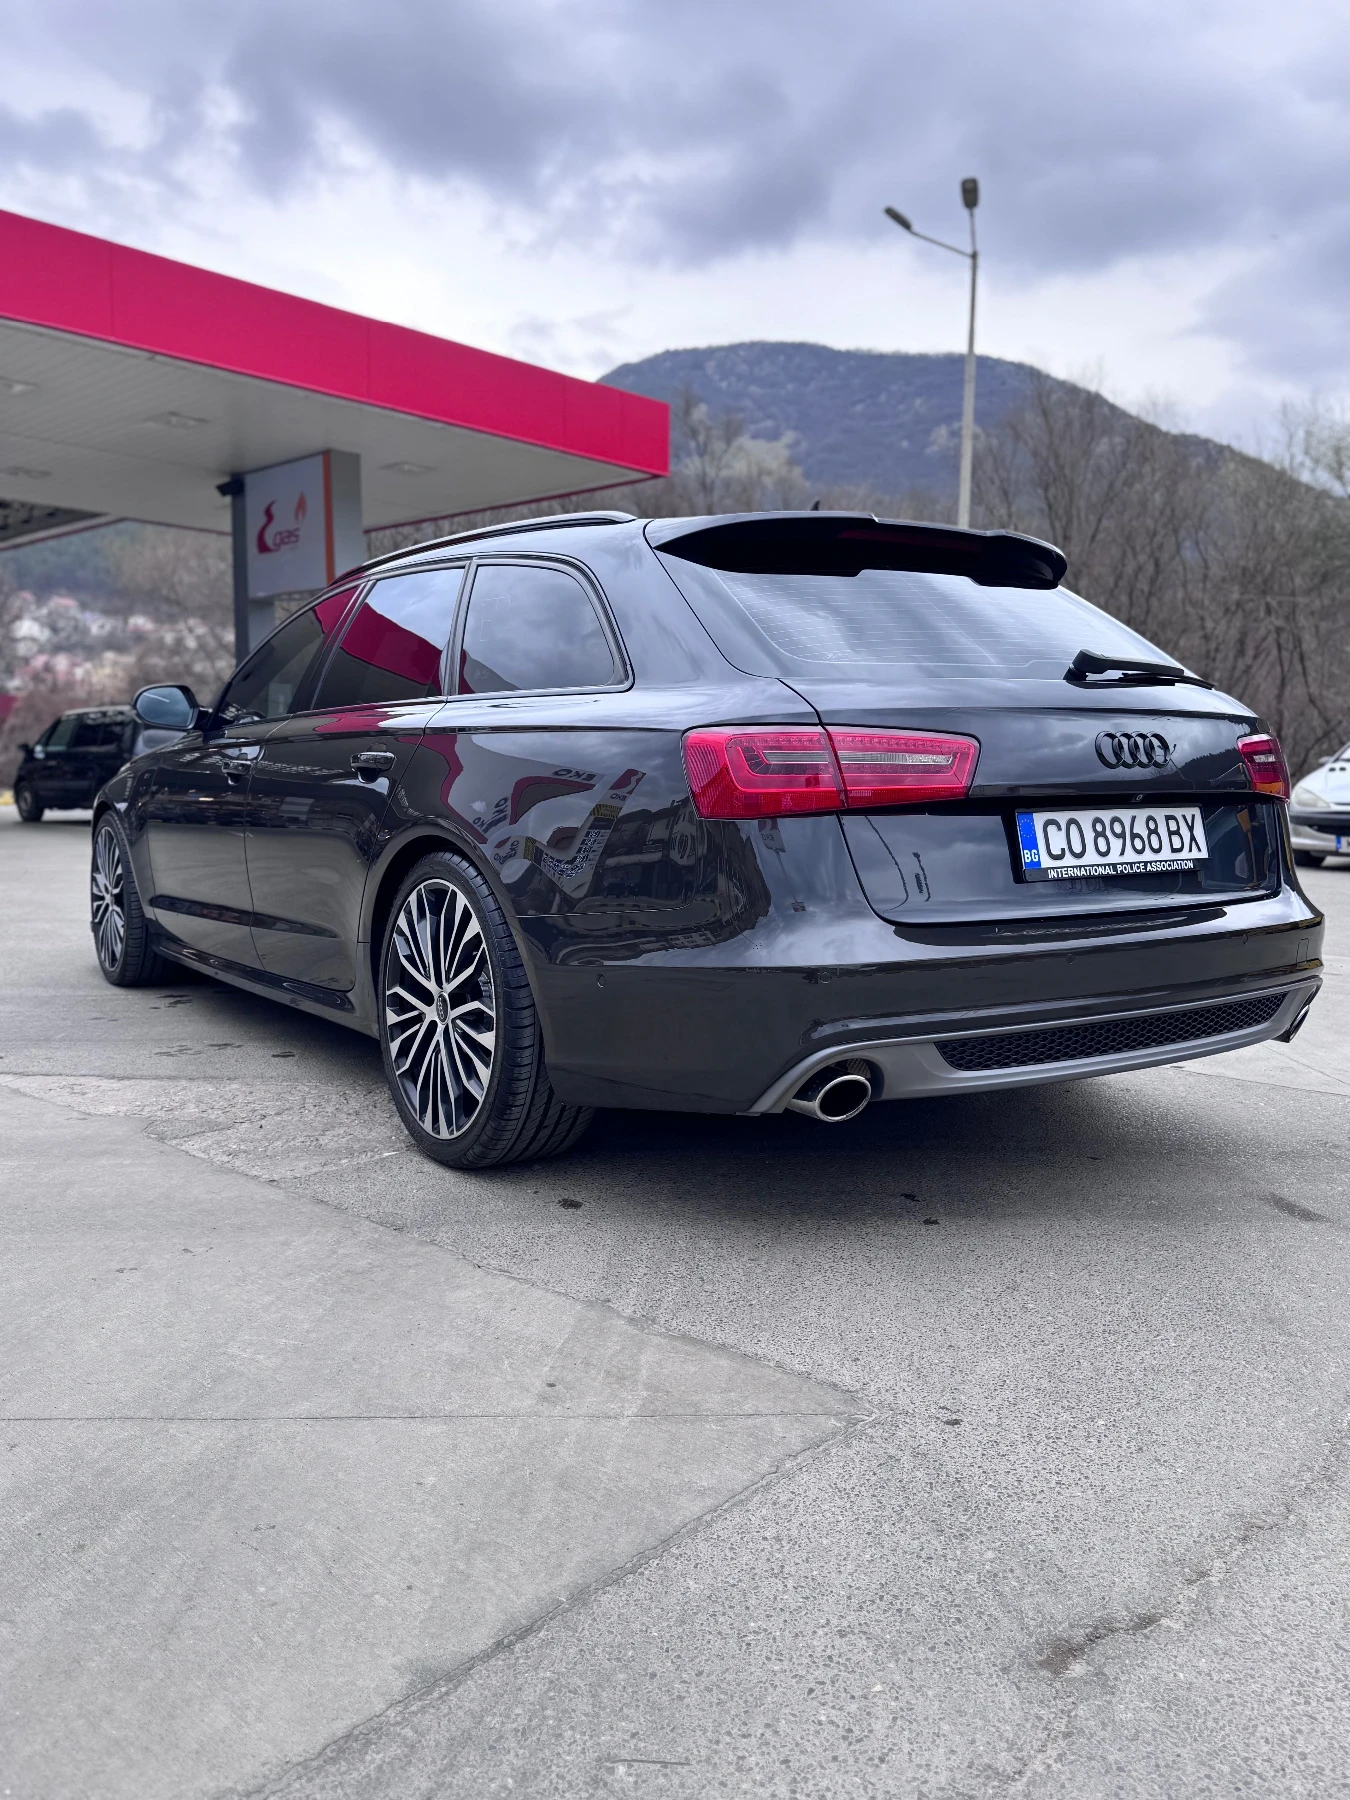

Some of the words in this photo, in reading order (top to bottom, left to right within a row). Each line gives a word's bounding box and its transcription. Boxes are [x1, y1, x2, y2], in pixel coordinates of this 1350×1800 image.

[1091, 815, 1163, 858] 8968
[1164, 813, 1202, 854] BX
[1024, 849, 1039, 863] BG
[1048, 863, 1116, 879] INTERNATIONAL
[1117, 862, 1146, 874] POLICE
[1147, 859, 1194, 872] ASSOCIATION
